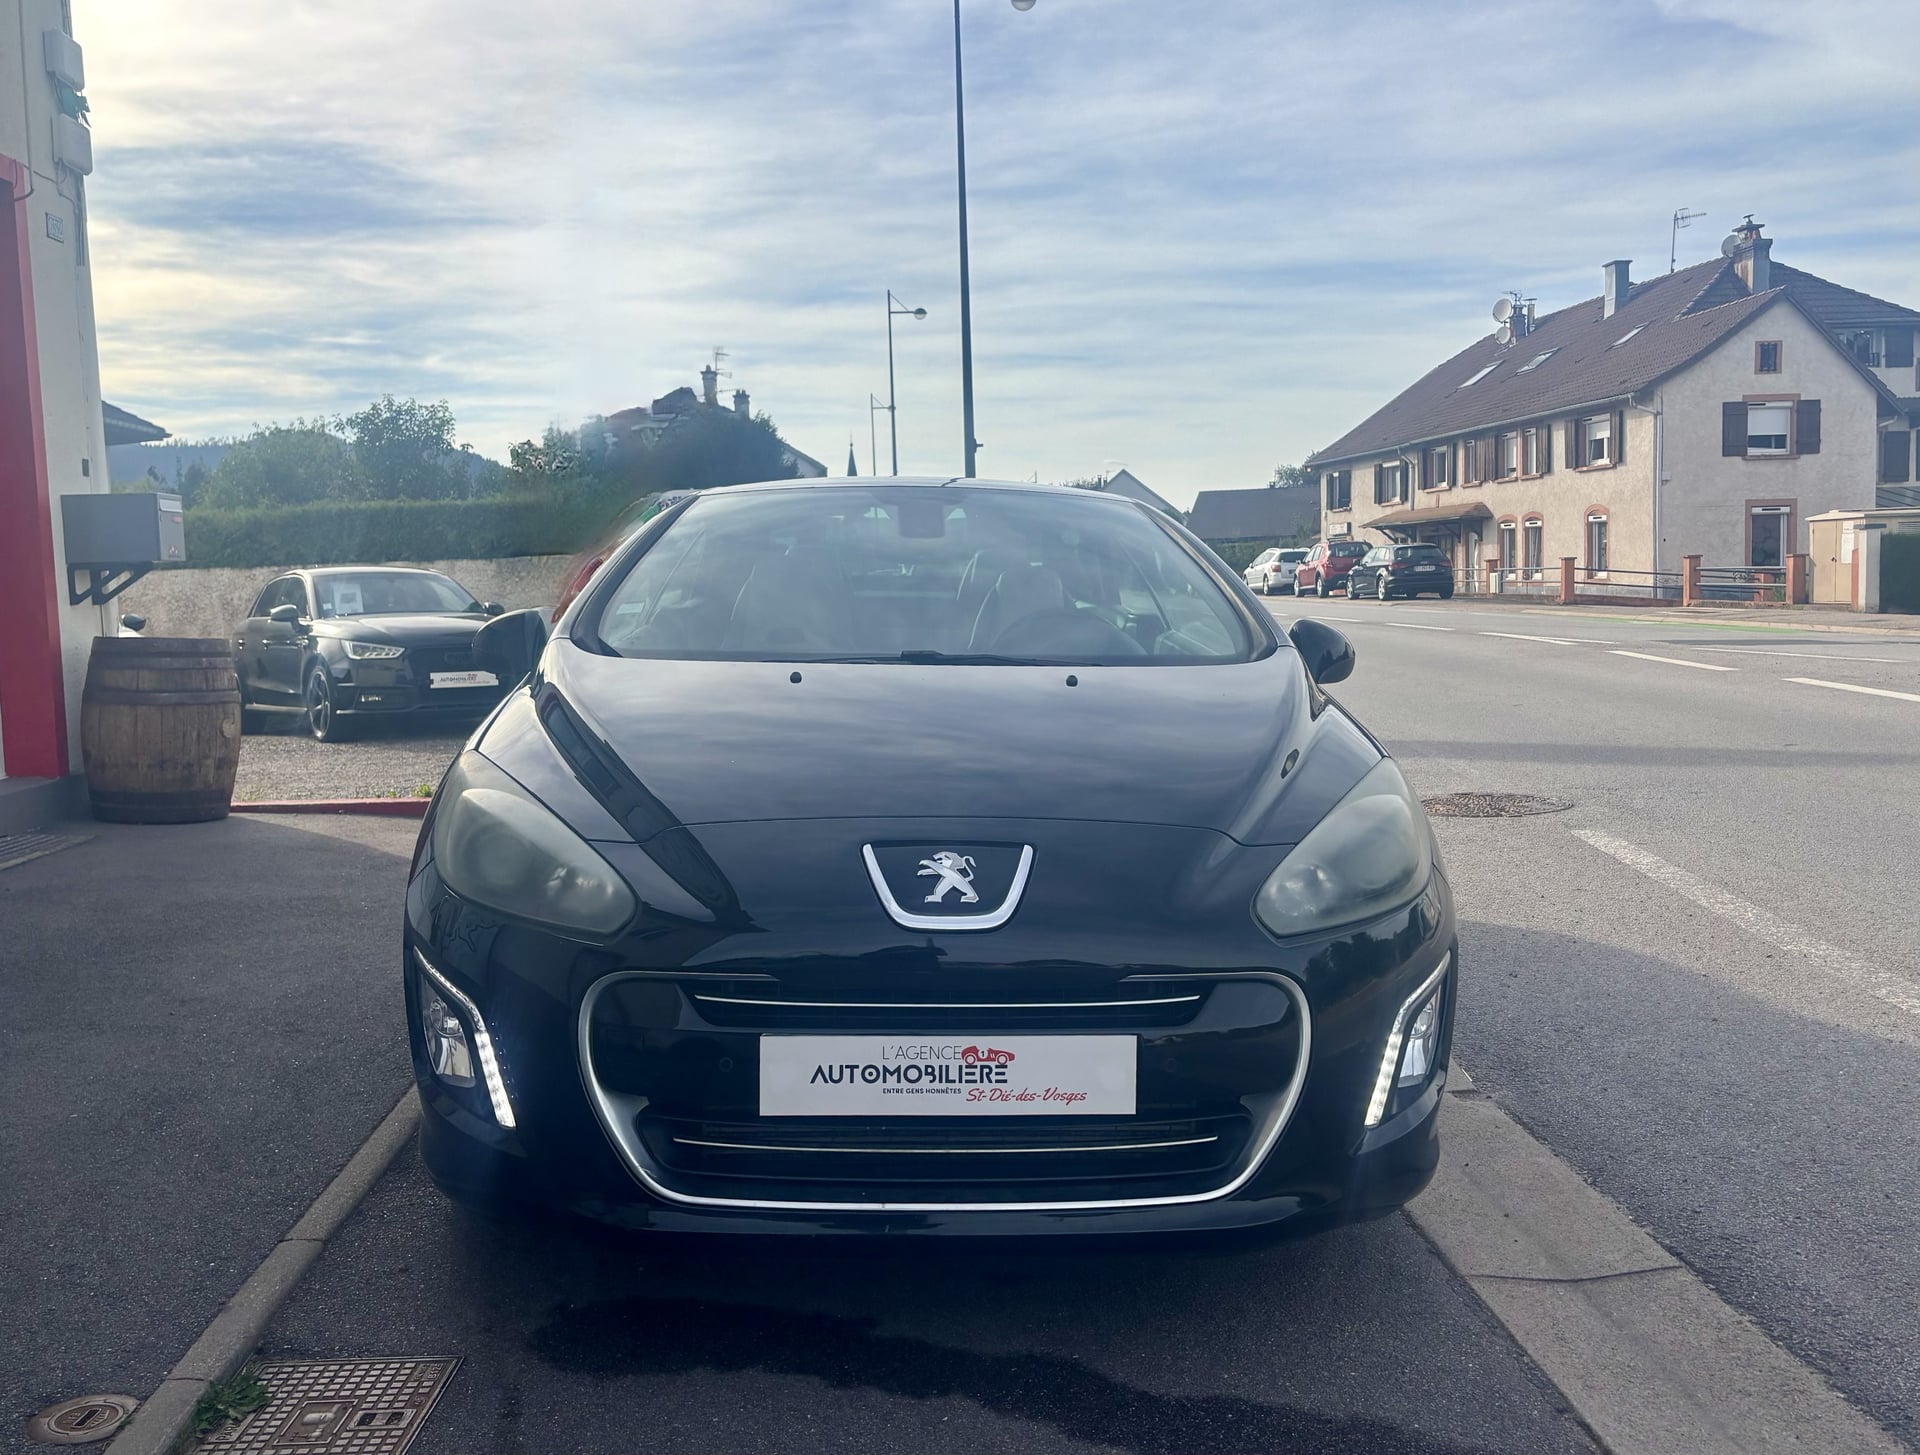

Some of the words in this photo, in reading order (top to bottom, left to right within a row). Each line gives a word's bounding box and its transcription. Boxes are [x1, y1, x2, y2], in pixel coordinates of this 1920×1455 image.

[882, 1045, 962, 1060] L'AGENCE
[810, 1064, 1008, 1084] AUTOMOBILIERE
[882, 1087, 905, 1095] ENTRE
[905, 1087, 925, 1095] GENS
[925, 1086, 962, 1095] HONNÊTES
[966, 1087, 1087, 1106] St-Dié-des-Vosges
